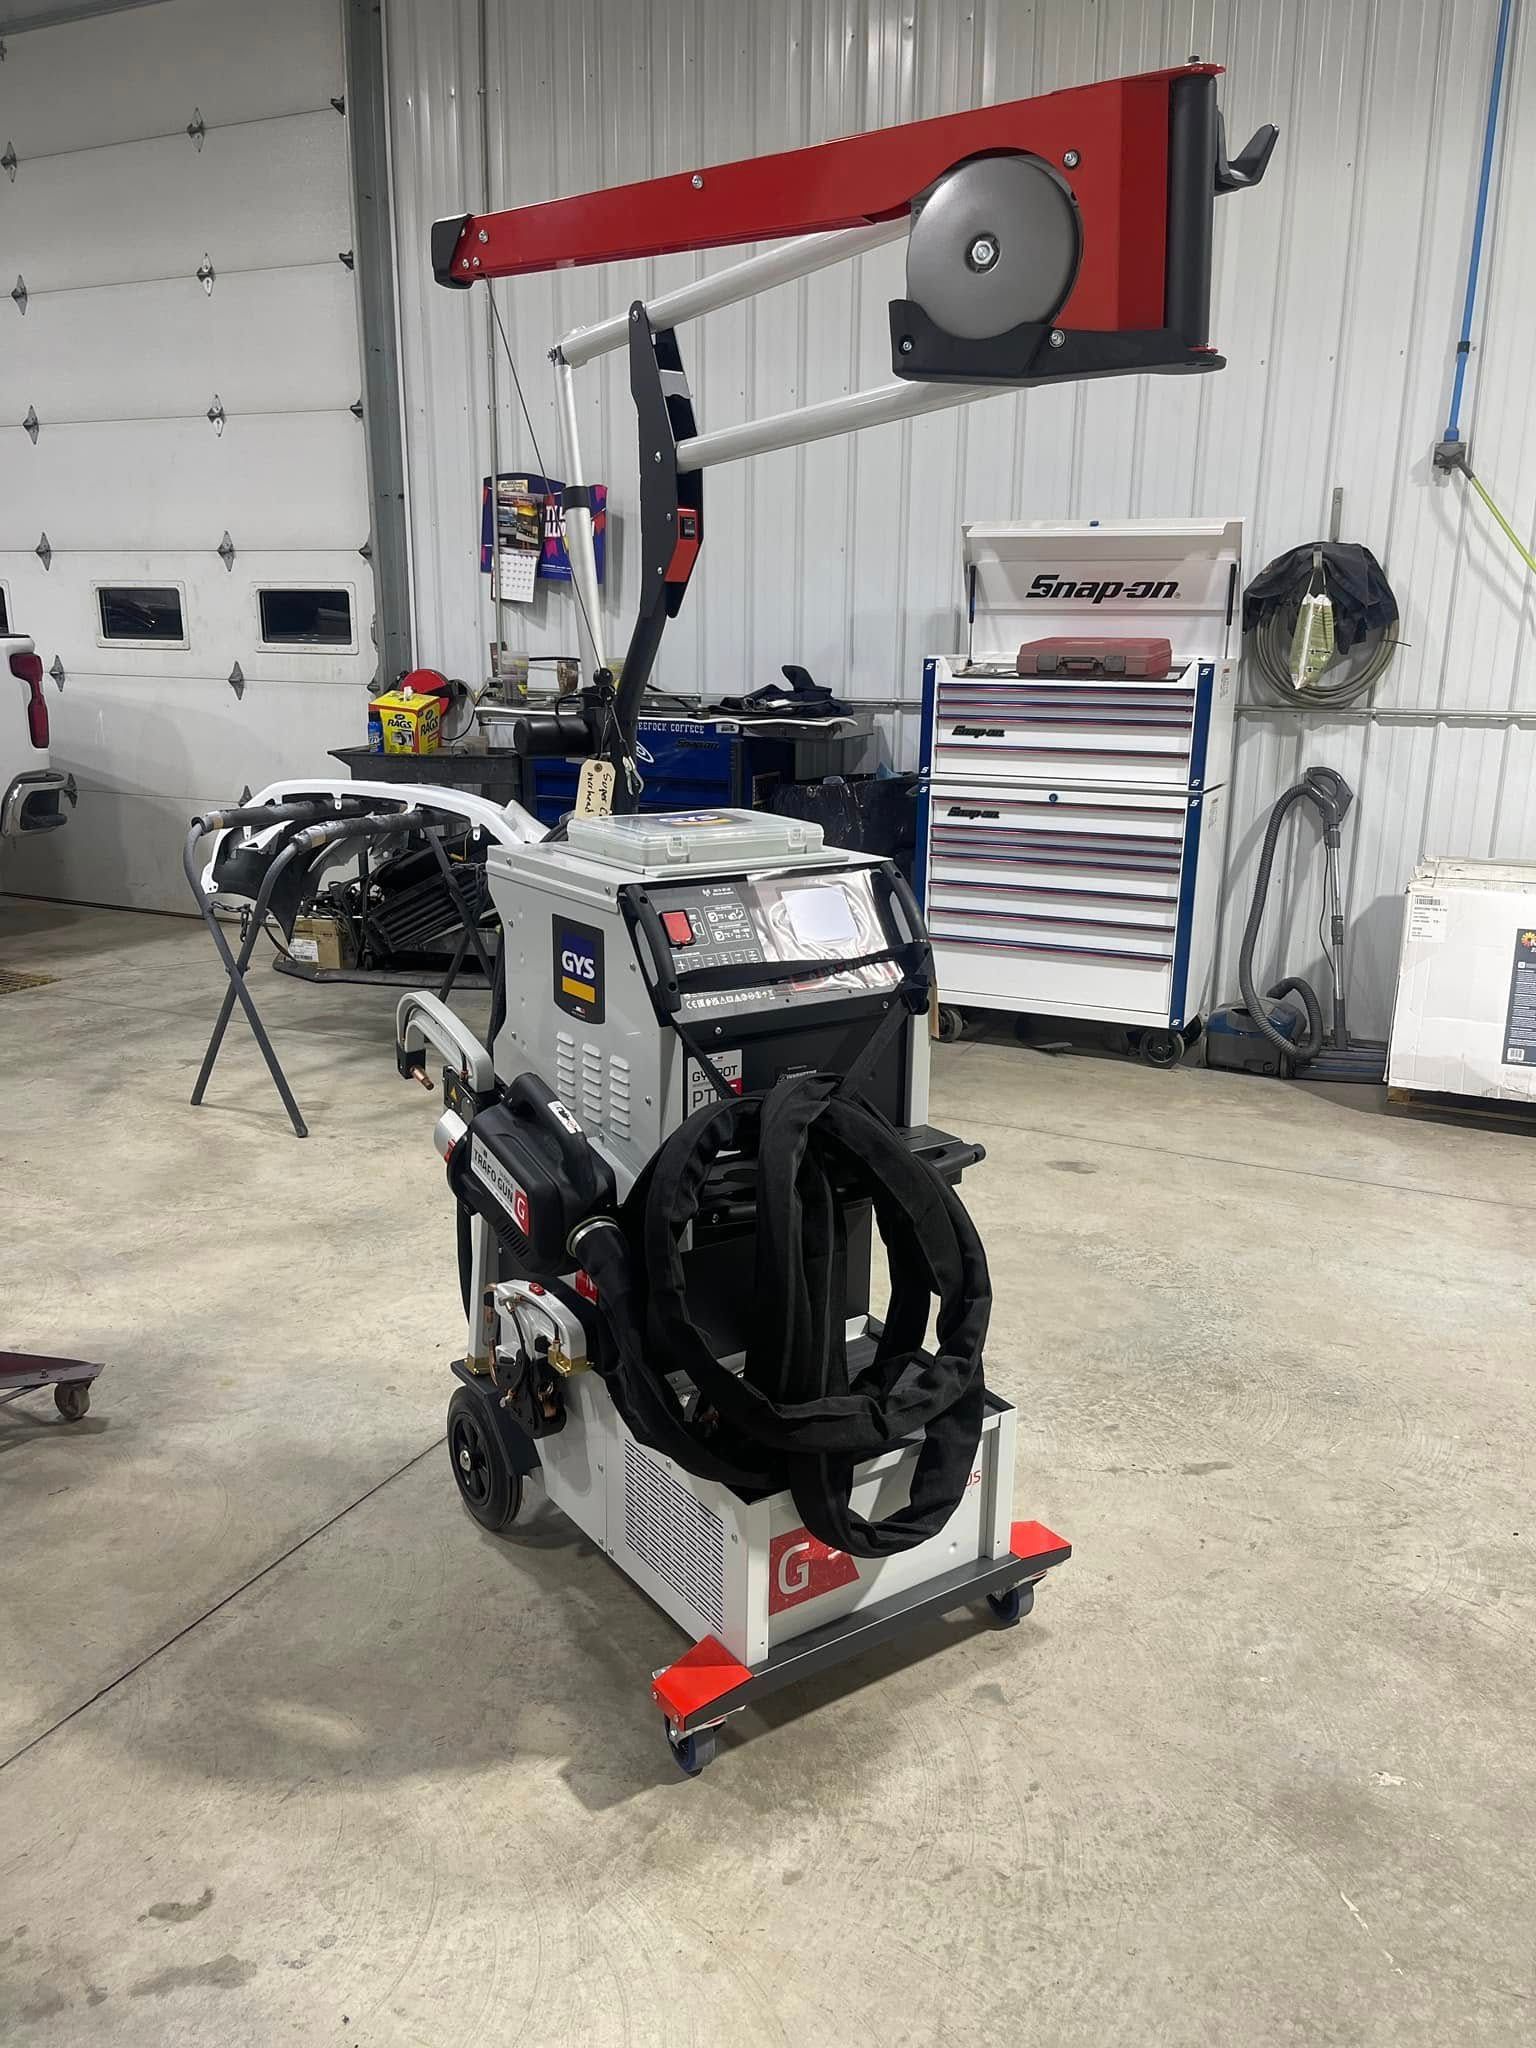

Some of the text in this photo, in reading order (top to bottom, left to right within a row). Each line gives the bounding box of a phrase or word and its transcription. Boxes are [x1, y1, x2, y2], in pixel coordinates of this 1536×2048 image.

[387, 719, 412, 728] RAGS
[421, 715, 439, 736] RAGS
[561, 950, 595, 979] GYS
[474, 1149, 513, 1203] TRAFO GUN
[778, 1541, 809, 1594] G
